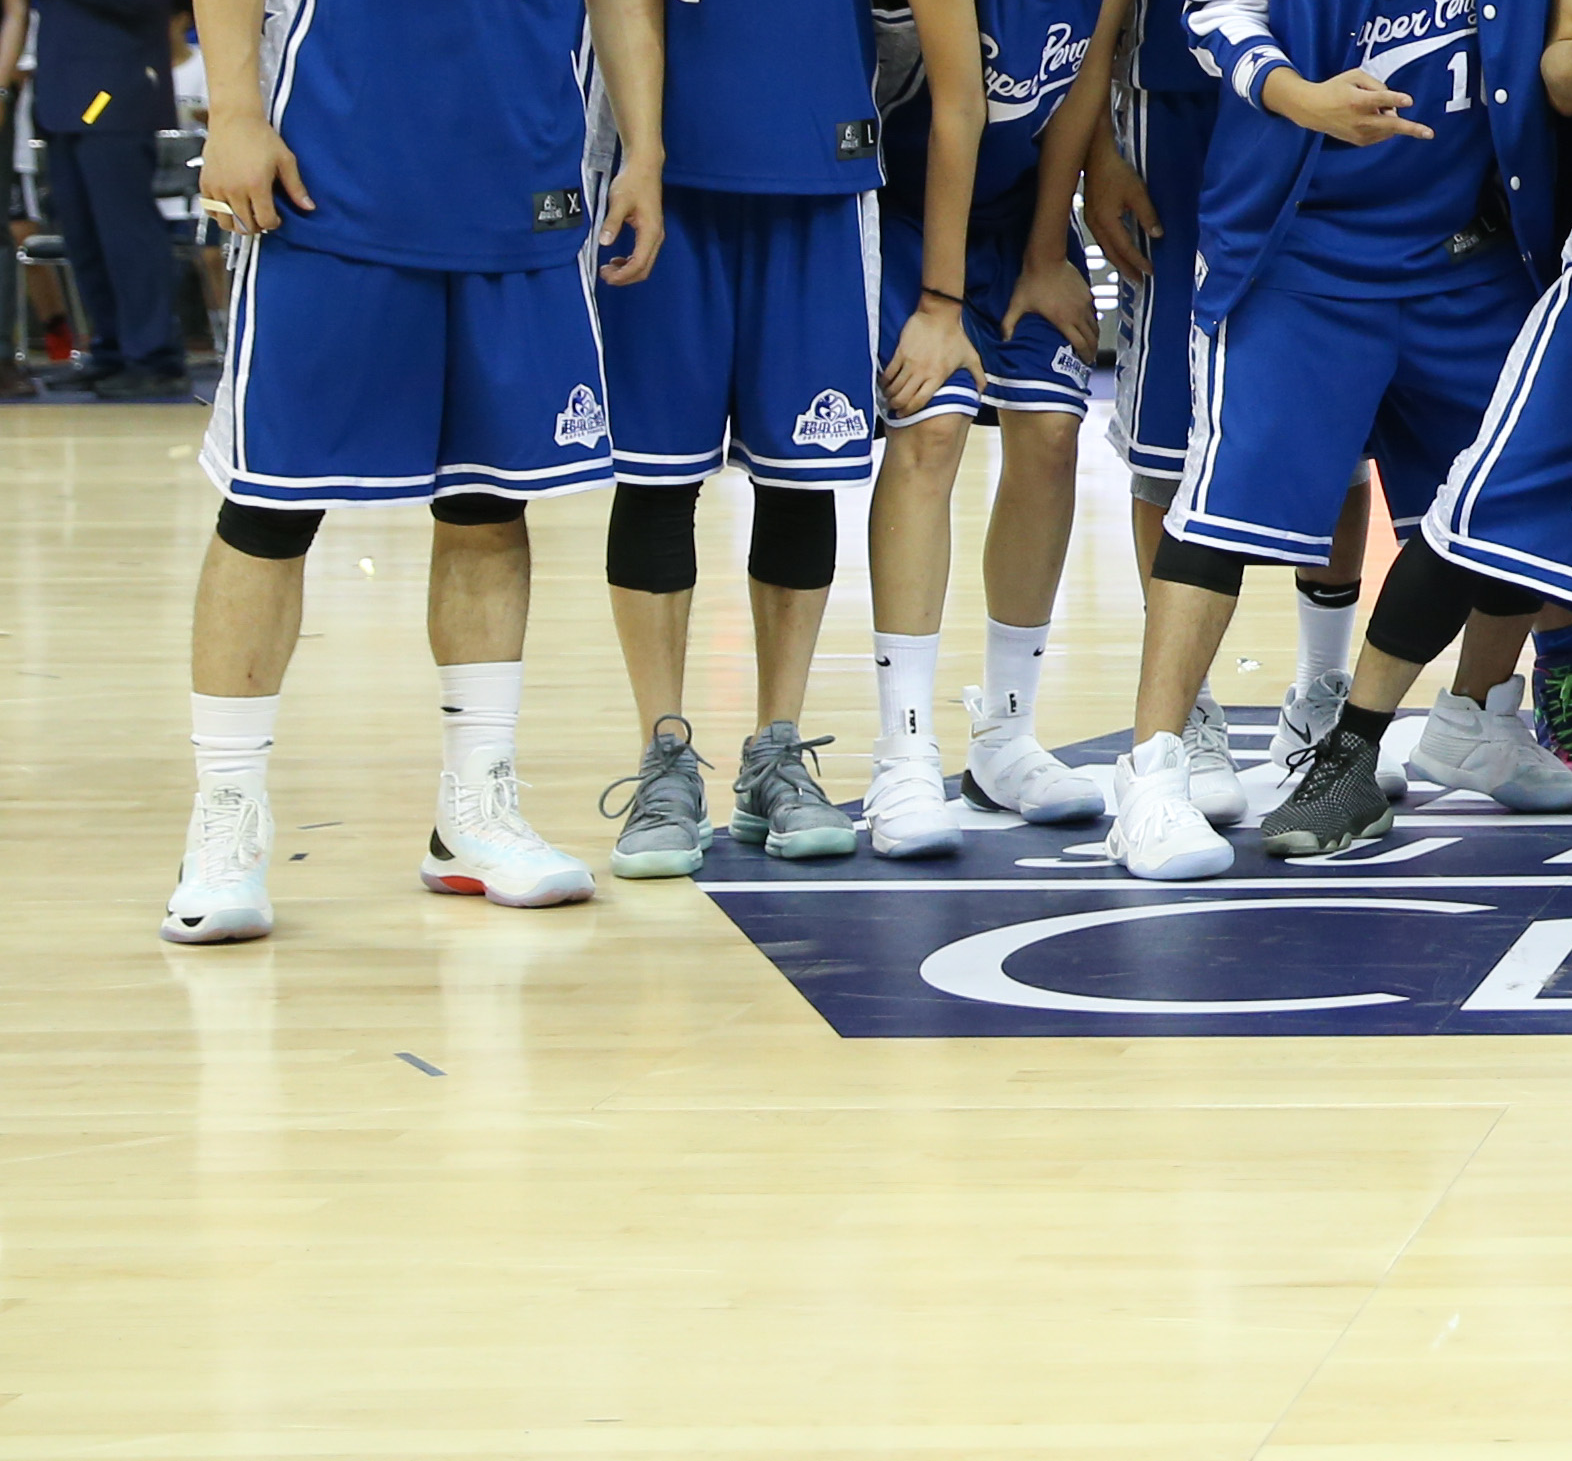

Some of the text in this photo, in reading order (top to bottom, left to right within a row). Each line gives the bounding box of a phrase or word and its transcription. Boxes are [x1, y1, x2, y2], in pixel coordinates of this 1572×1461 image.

[1040, 22, 1093, 84] Peng
[1356, 9, 1432, 58] uper
[1445, 51, 1472, 114] 1
[867, 124, 874, 144] L
[801, 415, 865, 436] 超级企鹅
